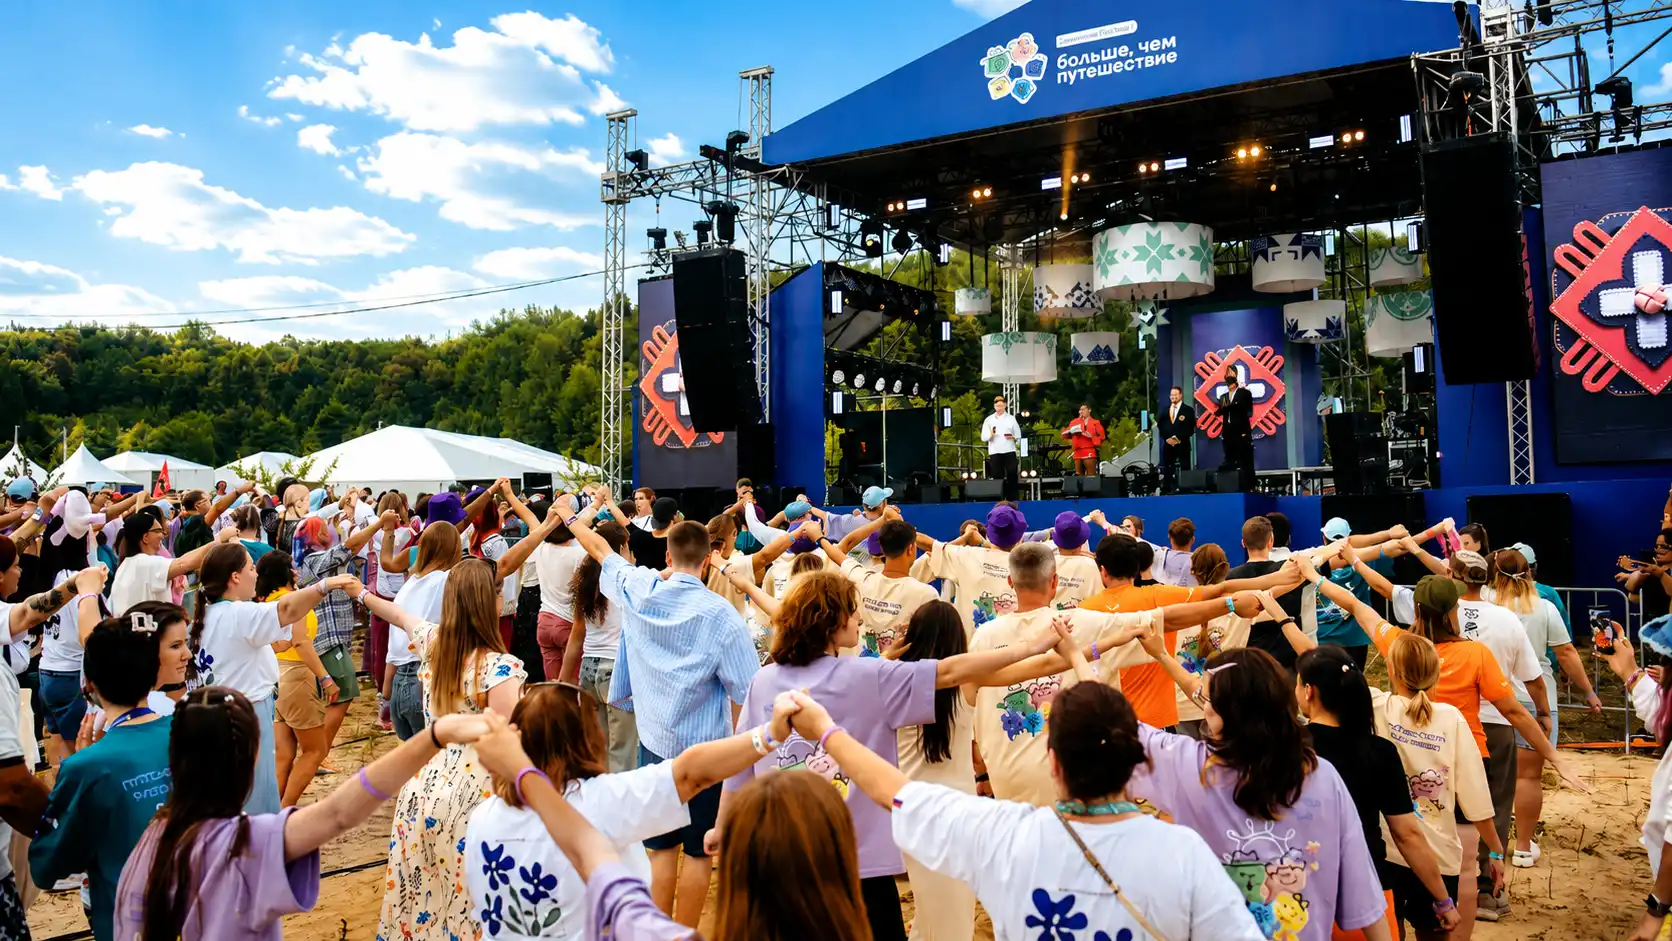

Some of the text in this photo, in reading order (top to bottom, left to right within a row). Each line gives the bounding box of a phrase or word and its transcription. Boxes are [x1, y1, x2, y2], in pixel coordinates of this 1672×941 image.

[1057, 36, 1177, 69] больше, чем
[1057, 51, 1178, 85] путешествие
